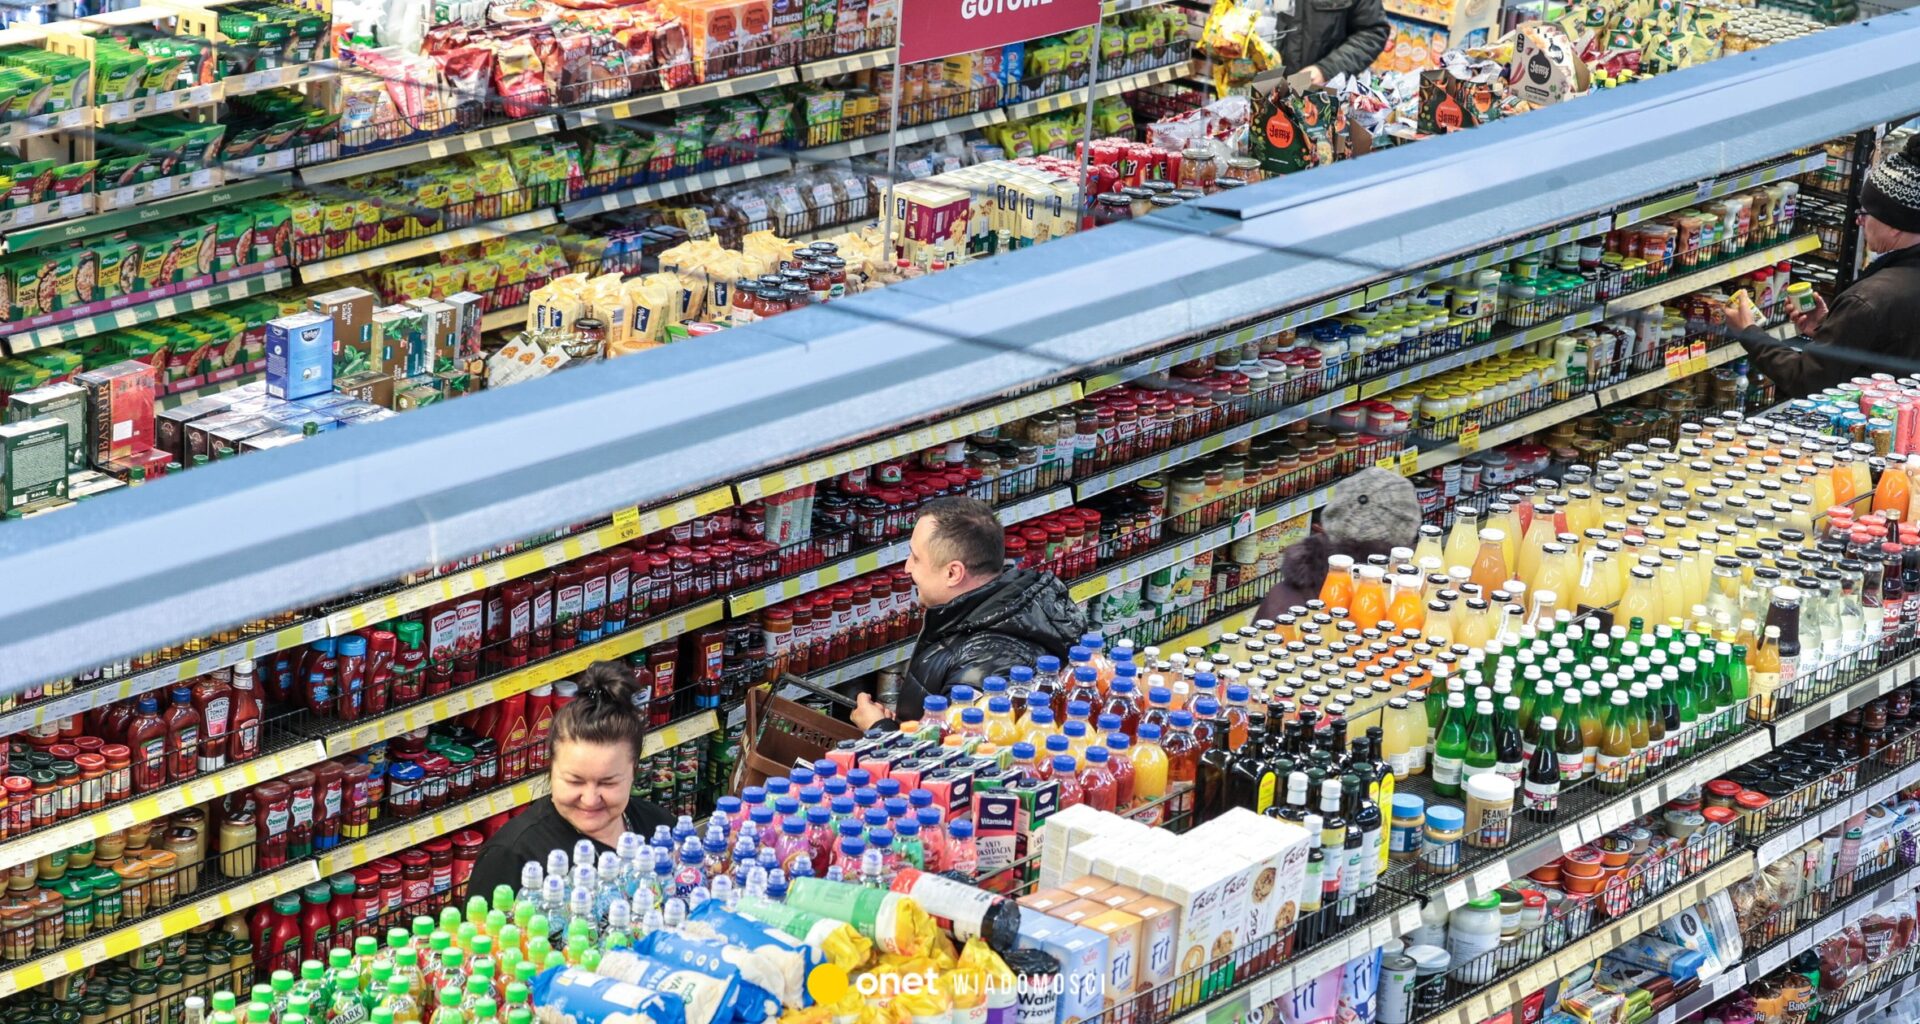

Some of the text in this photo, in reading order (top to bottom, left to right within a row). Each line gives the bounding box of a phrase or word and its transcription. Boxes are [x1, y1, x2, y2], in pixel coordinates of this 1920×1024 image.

[98, 383, 110, 451] BASILUR
[979, 817, 1013, 827] Vitaminka
[1482, 808, 1509, 818] PEANUT
[1111, 951, 1132, 986] Fit
[1151, 936, 1170, 970] Fit
[1352, 956, 1374, 1000] Fit
[1292, 979, 1317, 1019] Fit
